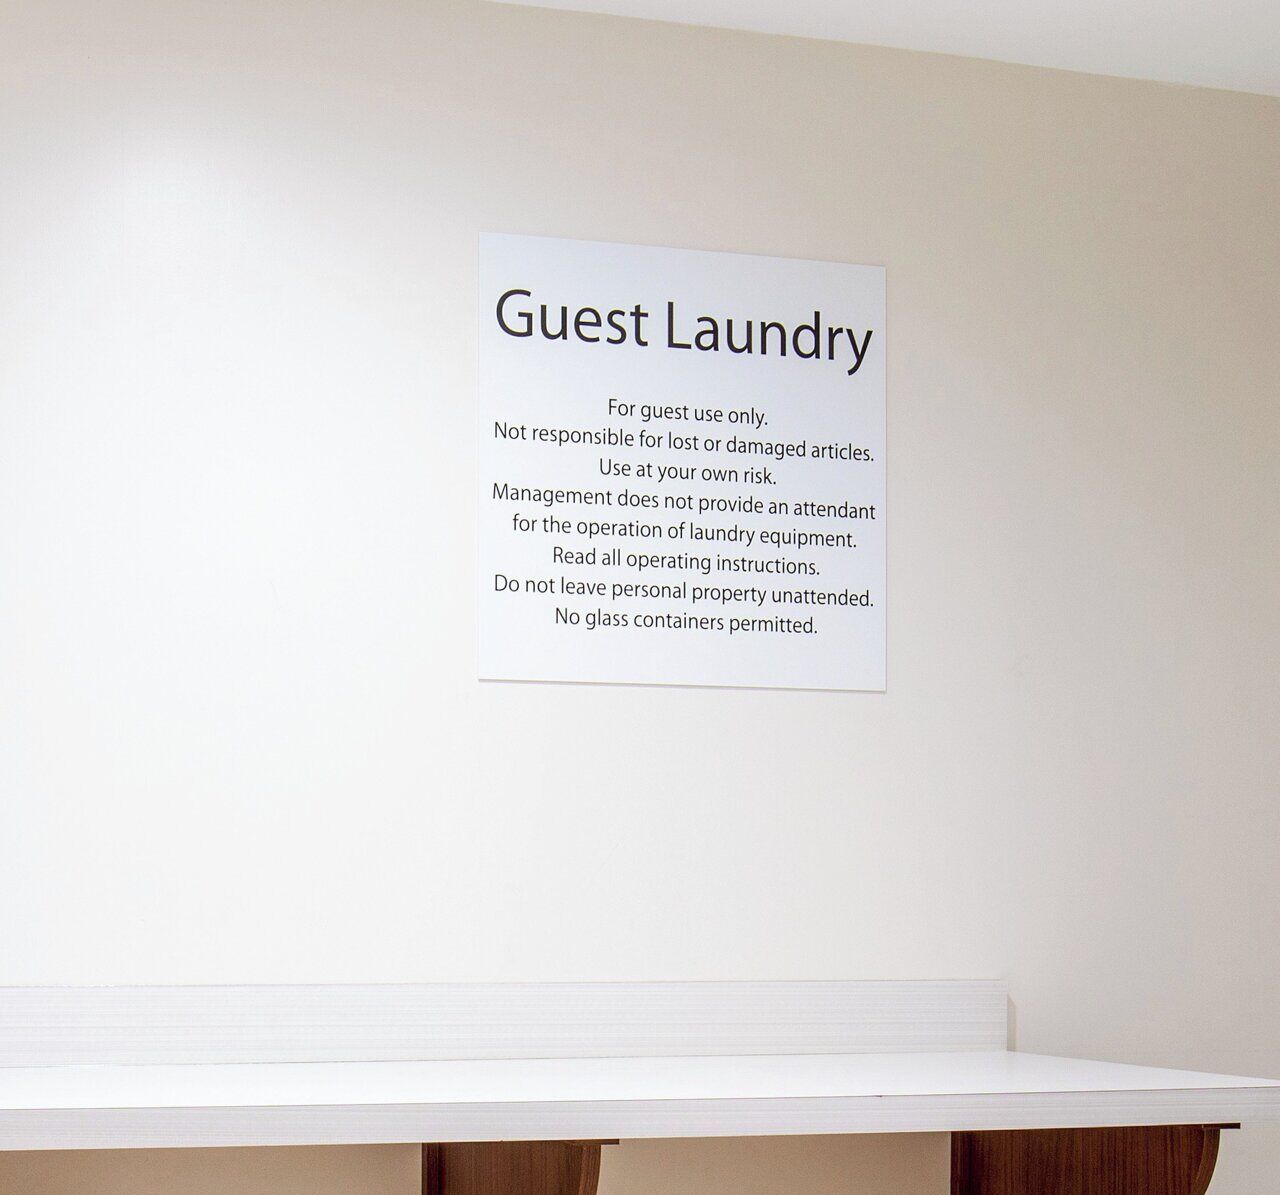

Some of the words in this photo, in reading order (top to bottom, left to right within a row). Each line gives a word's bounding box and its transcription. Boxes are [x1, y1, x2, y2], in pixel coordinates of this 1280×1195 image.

[496, 288, 649, 347] Guest
[667, 301, 874, 377] Laundry
[608, 398, 636, 417] For
[640, 404, 689, 423] guest
[694, 408, 724, 423] use
[728, 406, 768, 430] only.
[494, 421, 527, 441] Not
[532, 427, 635, 447] responsible
[639, 429, 664, 448] for
[668, 431, 700, 451] lost
[703, 438, 722, 452] or
[726, 435, 806, 461] damaged
[811, 442, 874, 462] articles.
[599, 458, 631, 477] Use
[636, 462, 653, 478] at
[657, 465, 697, 483] your
[701, 468, 738, 483] own
[744, 466, 777, 485] risk.
[492, 482, 613, 508] Management
[617, 488, 659, 508] does
[664, 494, 694, 510] not
[699, 495, 764, 515] provide
[768, 501, 789, 515] an
[793, 500, 876, 520] attendant
[512, 512, 538, 532] for
[542, 515, 572, 534] the
[576, 521, 662, 540] operation
[667, 521, 686, 539] of
[690, 522, 756, 548] laundry
[759, 530, 857, 550] equipment.
[553, 546, 596, 565] Read
[601, 548, 621, 566] all
[626, 552, 711, 575] operating
[717, 557, 820, 576] instructions.
[494, 574, 520, 592] Do
[525, 578, 556, 594] not
[561, 576, 607, 596] leave
[612, 581, 686, 601] personal
[692, 587, 767, 607] property
[772, 588, 874, 607] unattended.
[555, 607, 580, 625] No
[585, 608, 629, 631] glass
[633, 612, 724, 631] containers
[729, 616, 818, 635] permitted.
